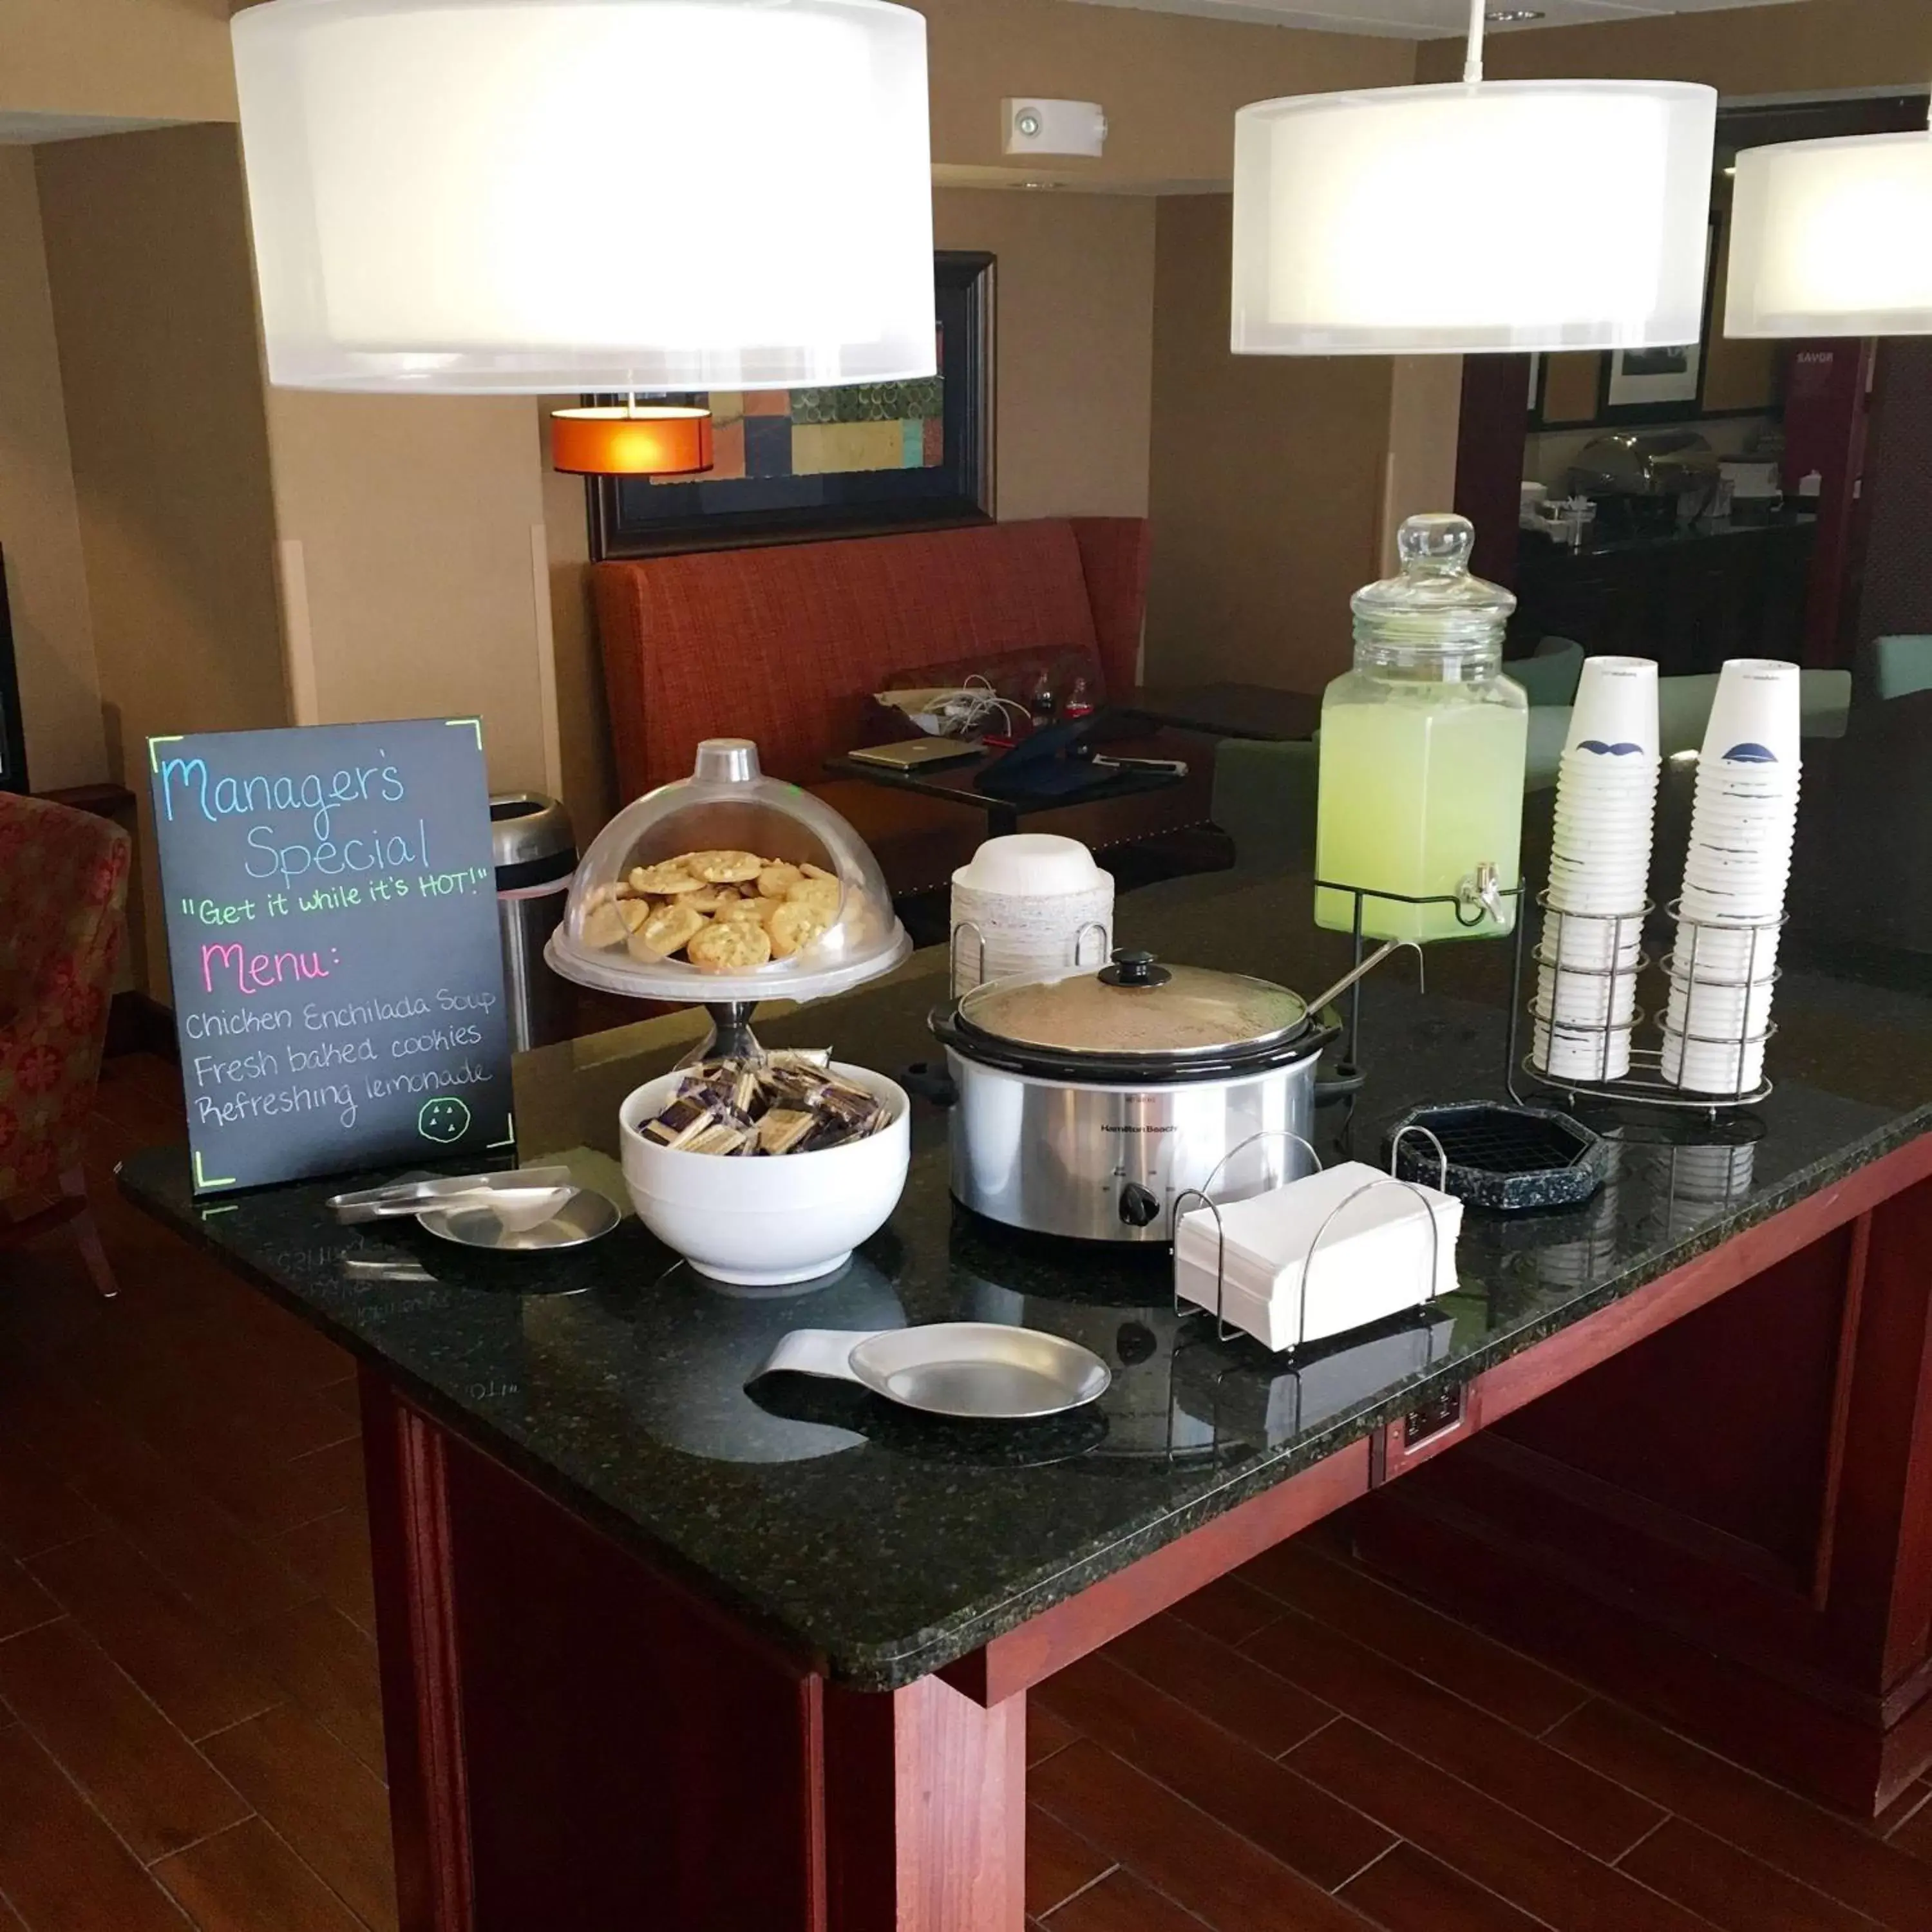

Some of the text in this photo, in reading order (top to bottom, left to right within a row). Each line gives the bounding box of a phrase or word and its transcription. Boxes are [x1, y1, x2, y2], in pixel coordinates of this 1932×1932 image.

[162, 748, 404, 840] Manager's
[244, 819, 430, 890] Special
[182, 867, 490, 926] "Get it while it's HOT!"
[201, 943, 341, 994] Menu:
[185, 988, 497, 1039] Chicken Enchilada Soup
[194, 1023, 482, 1087] Fresh baked cookies
[194, 1057, 494, 1128] Refreshing lemonade
